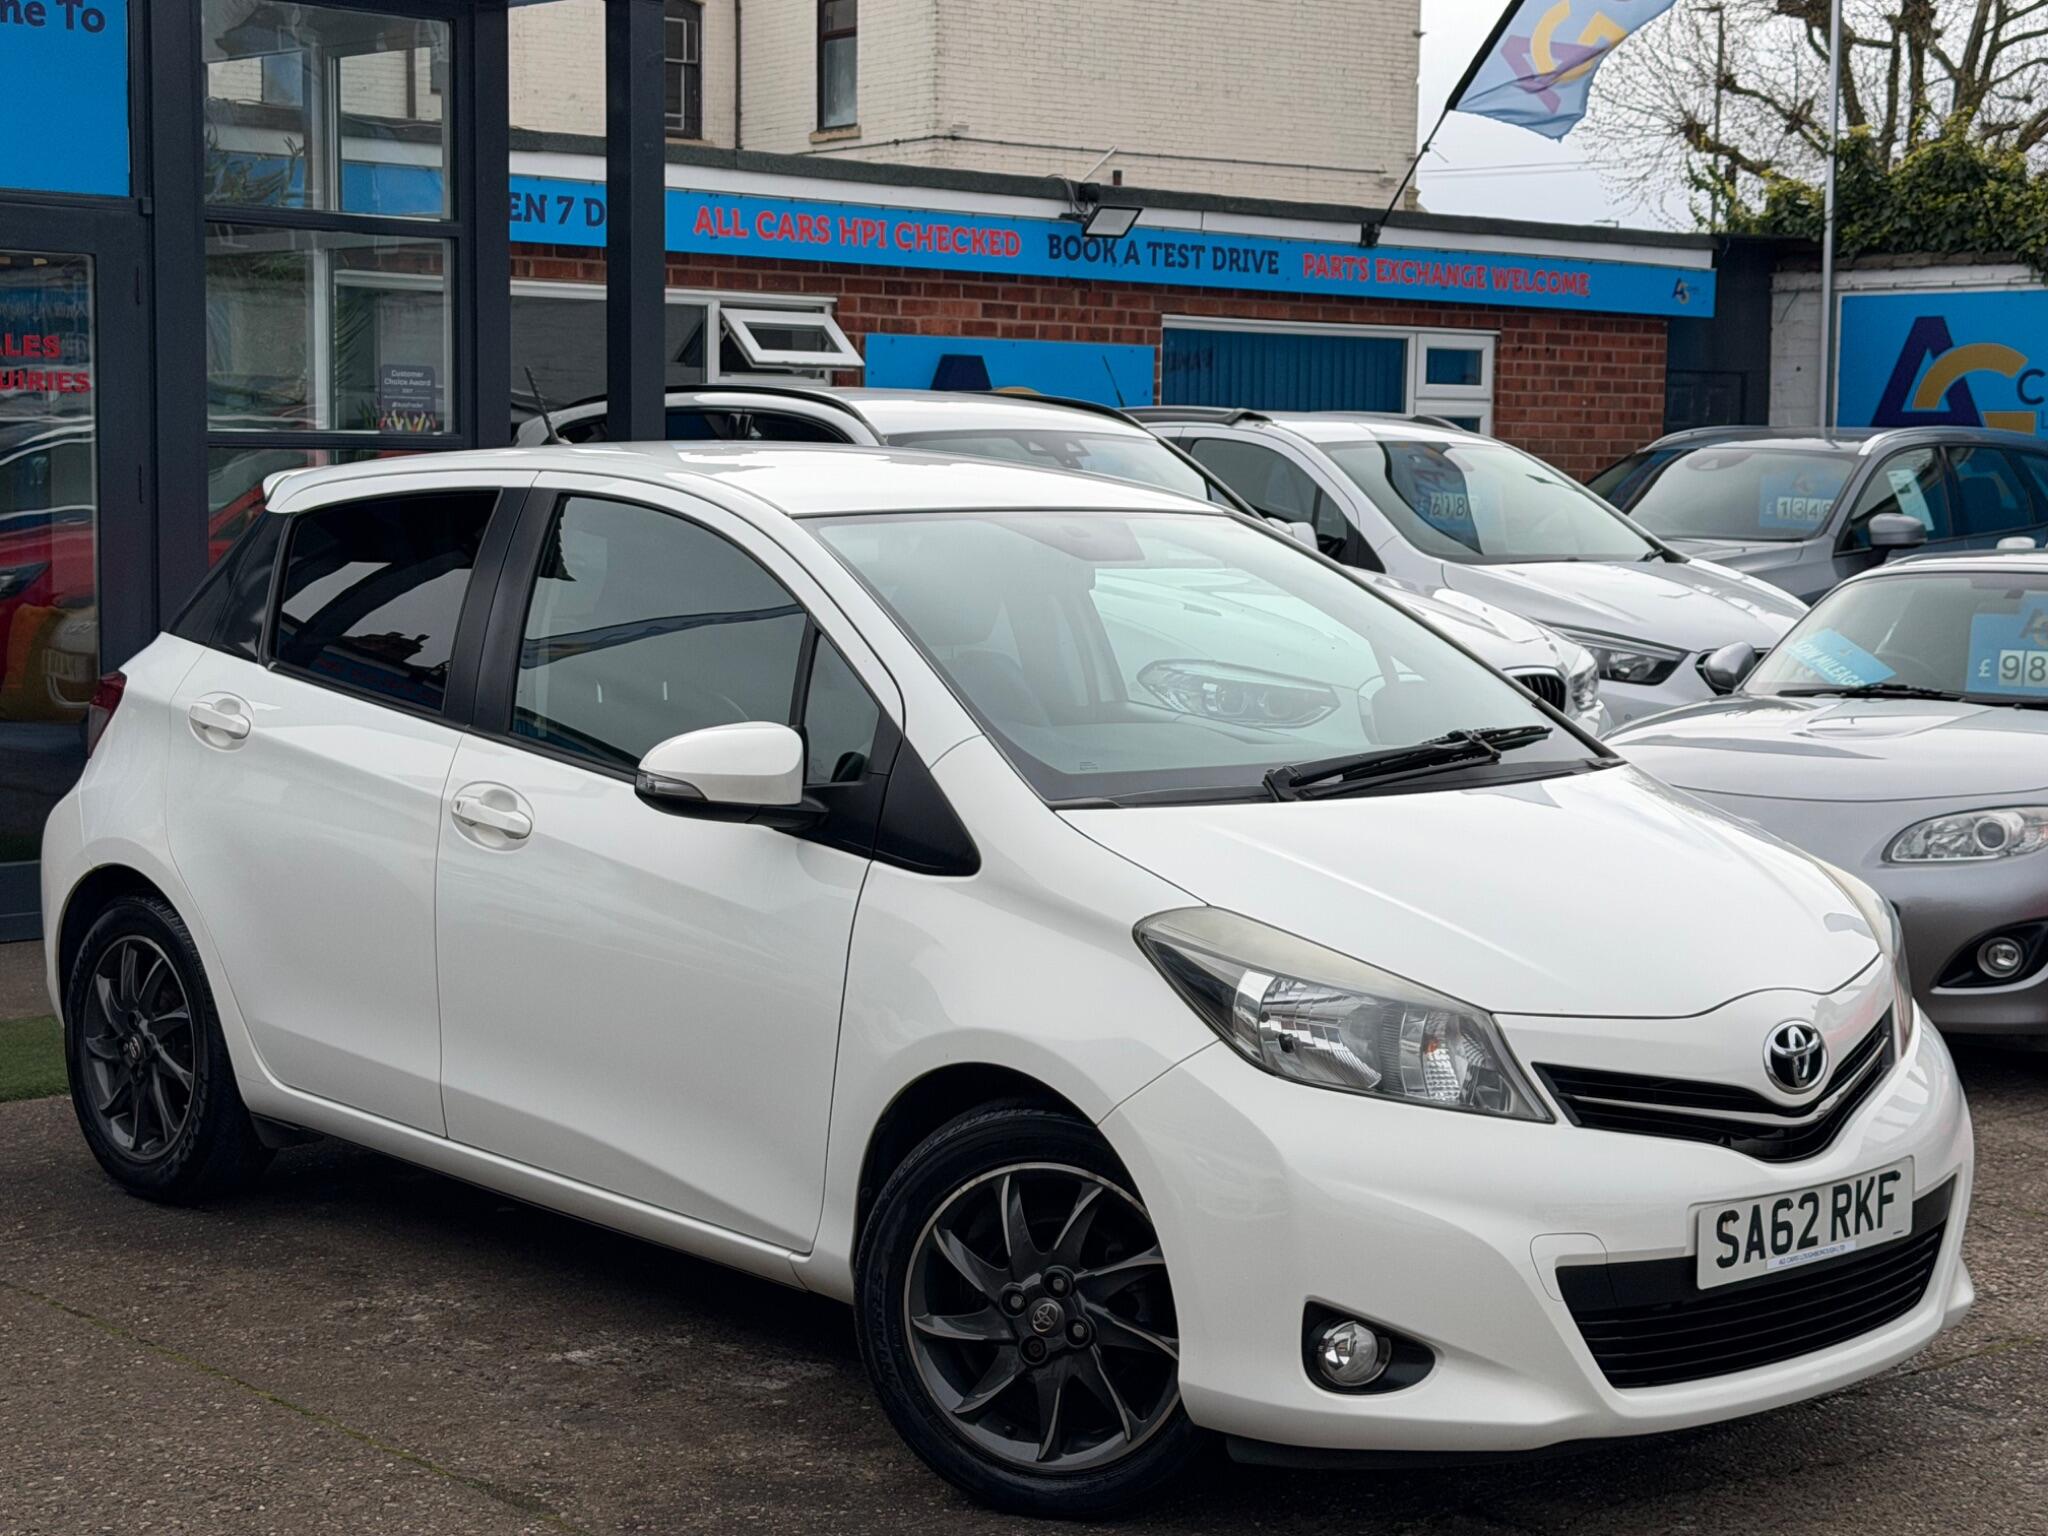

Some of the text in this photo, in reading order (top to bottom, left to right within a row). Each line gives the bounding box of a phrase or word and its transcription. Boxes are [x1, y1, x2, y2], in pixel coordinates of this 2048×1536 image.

[55, 0, 106, 33] To
[556, 195, 576, 225] 7
[693, 206, 1022, 257] ALL CARS HPI CHECKED
[1047, 234, 1280, 275] BOOK A TEST DRIVE
[1302, 253, 1591, 297] PARTS EXCHANGE WELCOME
[0, 333, 62, 359] LES
[391, 369, 424, 378] Customer
[409, 379, 432, 387] Award
[1716, 1169, 1901, 1269] SA62 RKF
